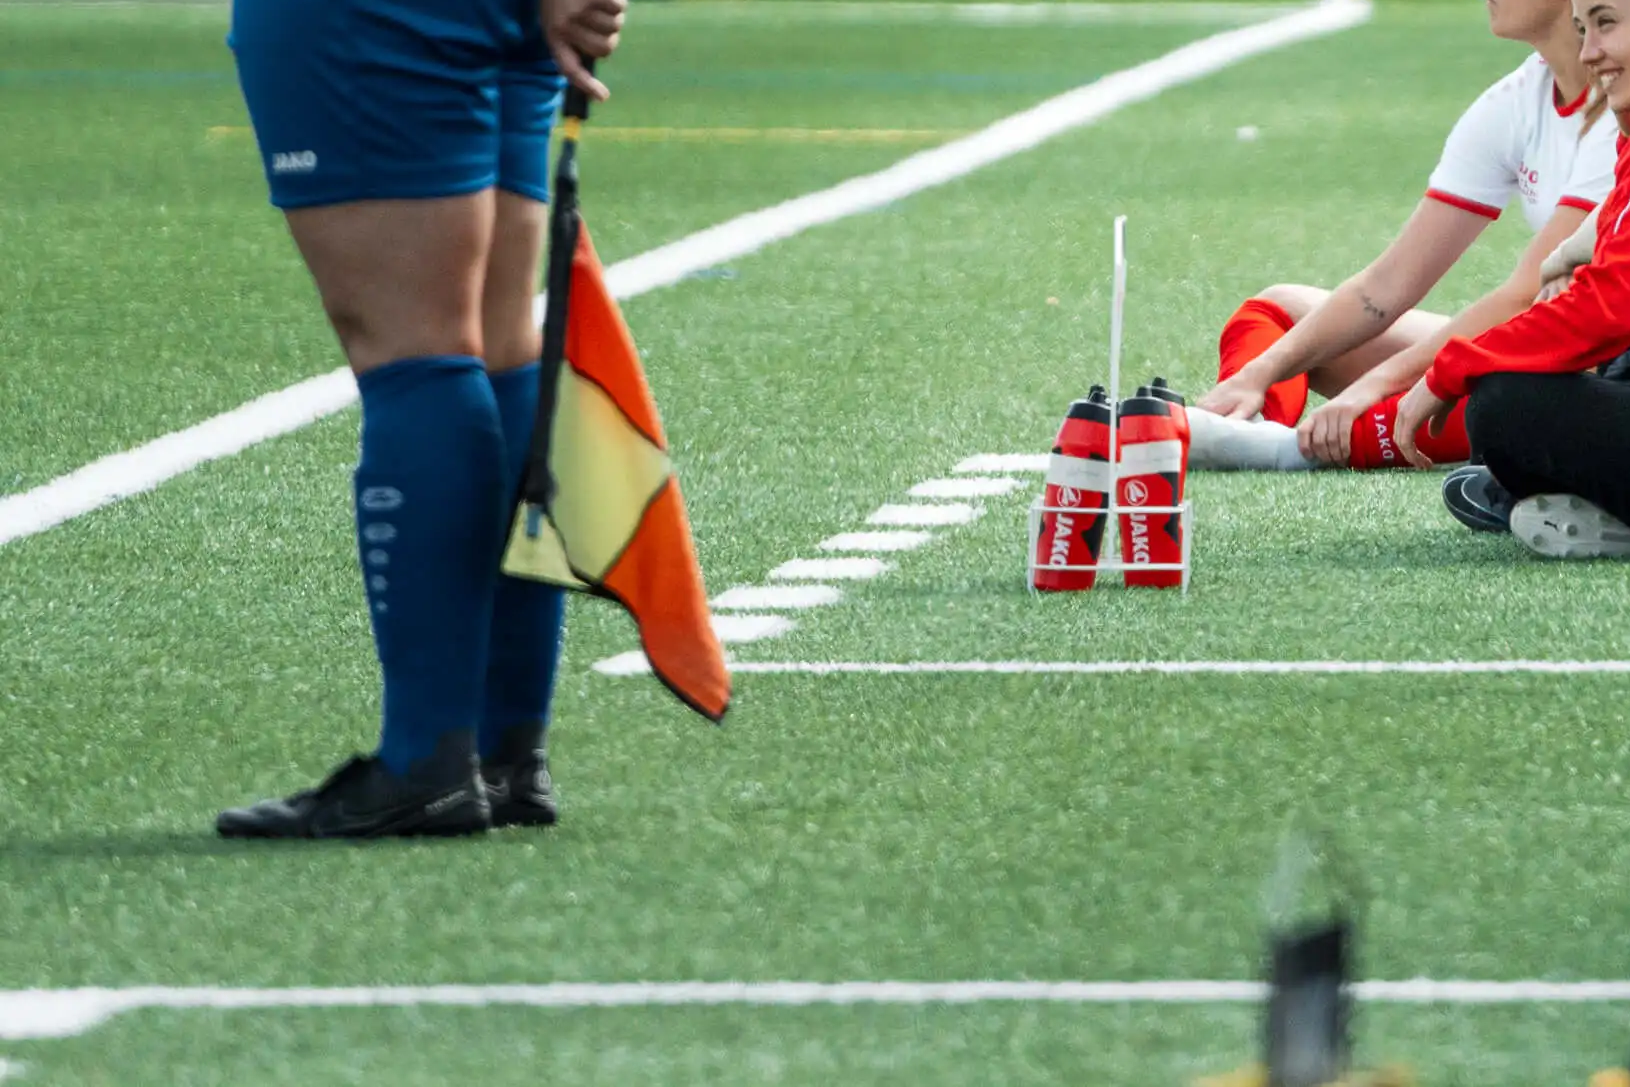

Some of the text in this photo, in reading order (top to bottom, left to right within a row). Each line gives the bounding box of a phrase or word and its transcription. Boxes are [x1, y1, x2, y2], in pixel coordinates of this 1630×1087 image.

[1374, 413, 1395, 460] JAKO
[1049, 513, 1075, 570] JAKO
[1129, 513, 1151, 565] JAKO
